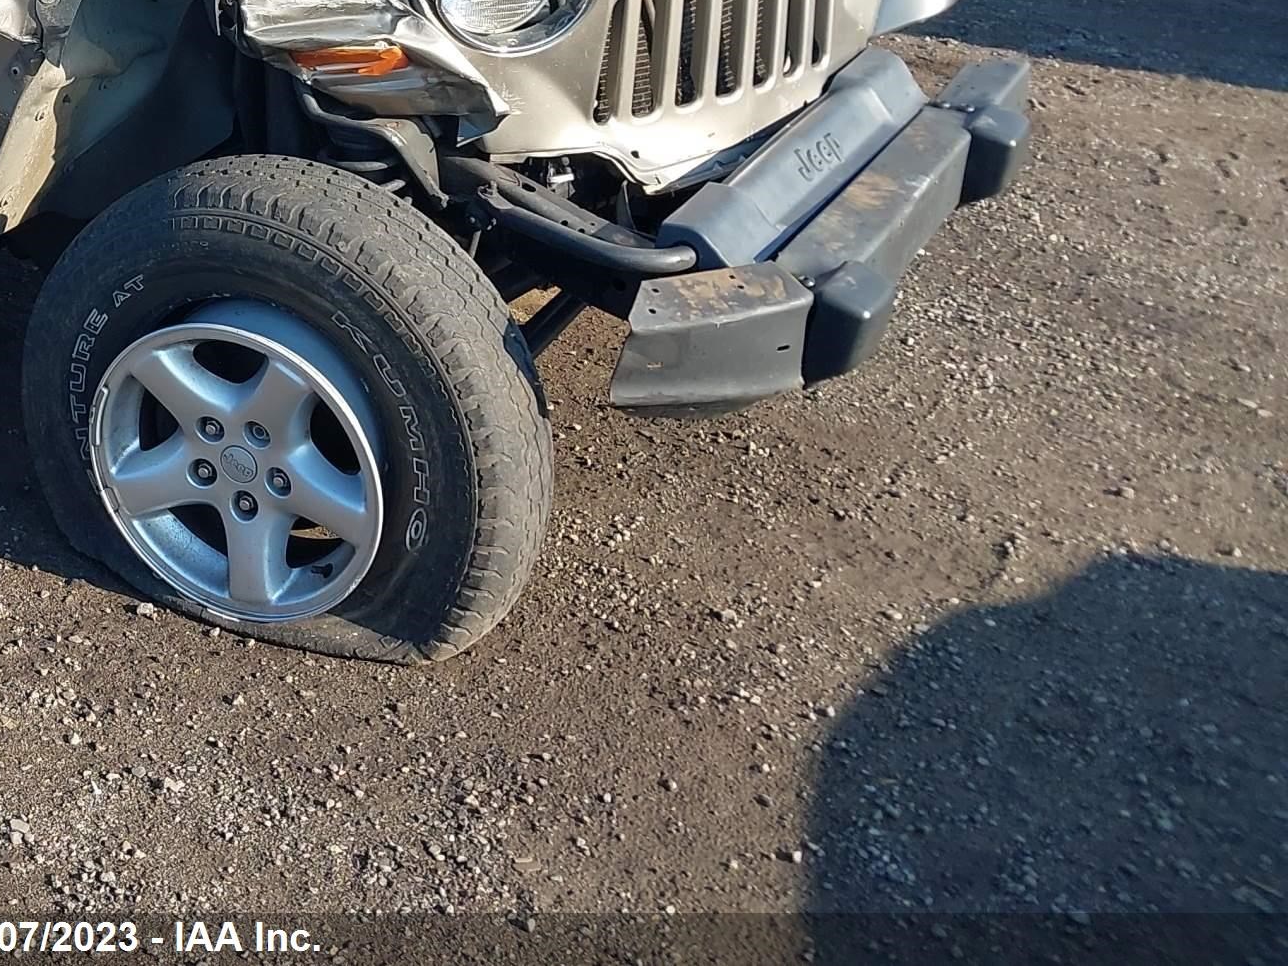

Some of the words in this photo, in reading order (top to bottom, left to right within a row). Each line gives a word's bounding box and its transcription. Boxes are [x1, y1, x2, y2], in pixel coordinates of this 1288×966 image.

[793, 132, 842, 182] Jeep
[112, 273, 145, 308] AT
[331, 310, 431, 552] KUMHO
